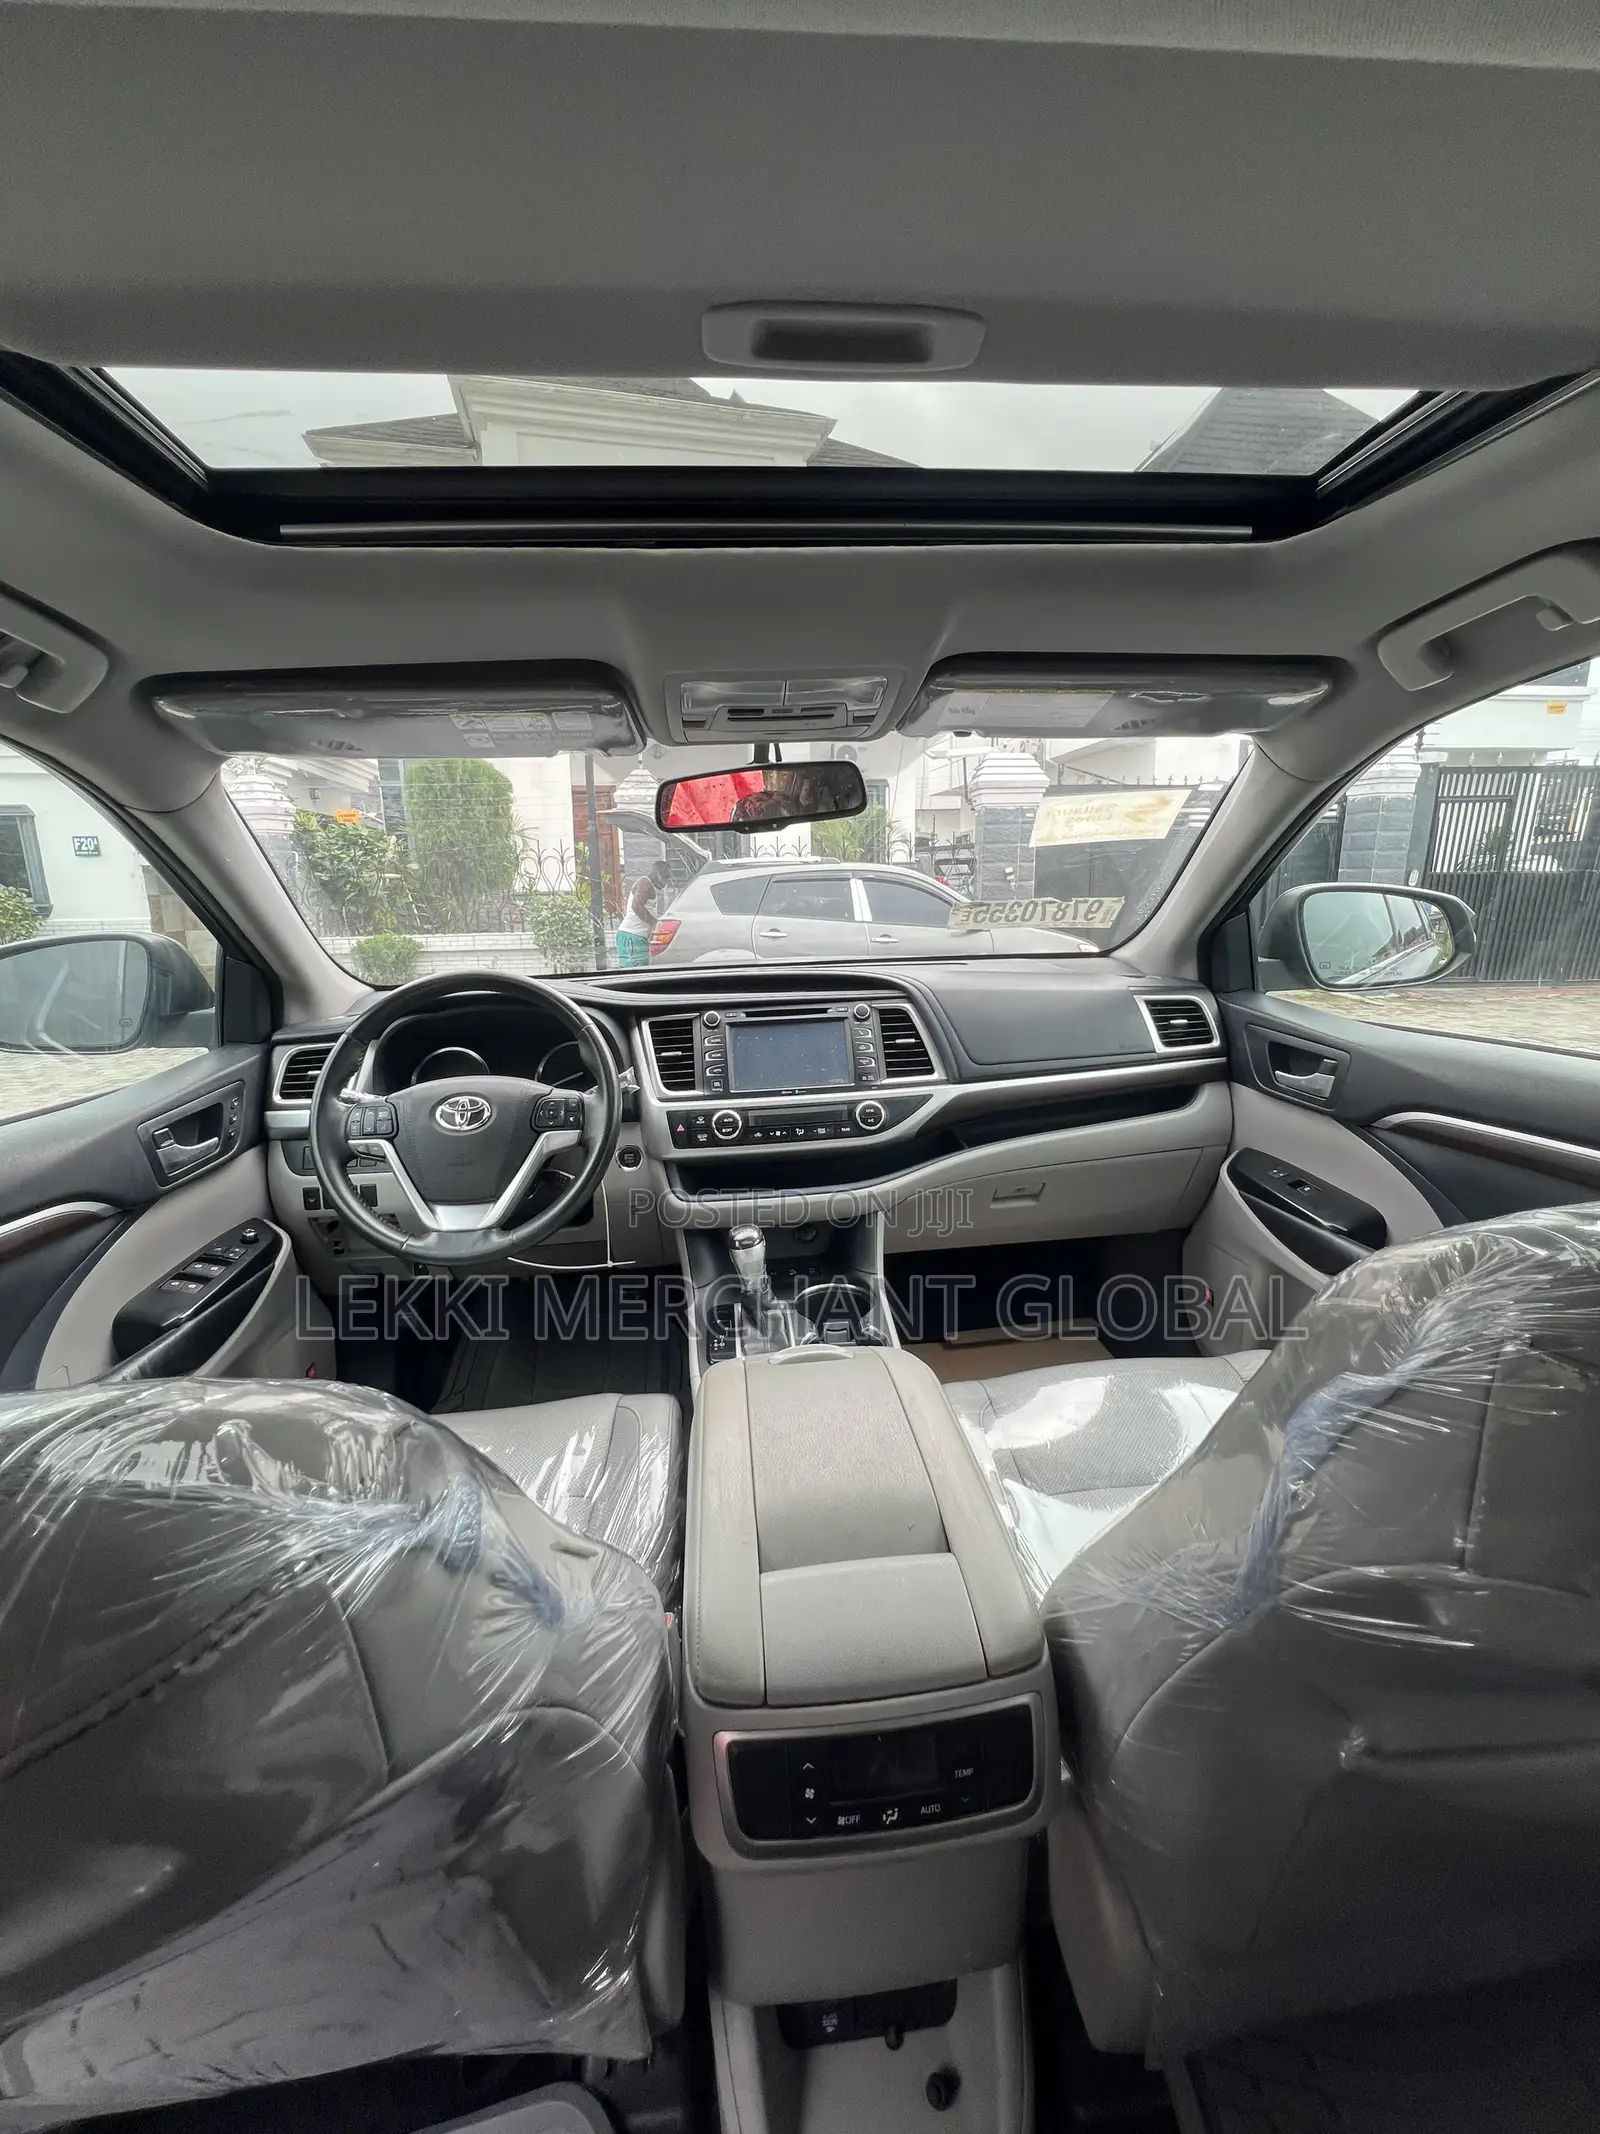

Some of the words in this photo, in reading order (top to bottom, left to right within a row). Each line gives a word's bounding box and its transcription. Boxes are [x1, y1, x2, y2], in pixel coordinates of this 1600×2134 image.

[954, 1767, 974, 1779] TEMP
[920, 1804, 941, 1815] AUTO
[844, 1814, 861, 1825] OFF
